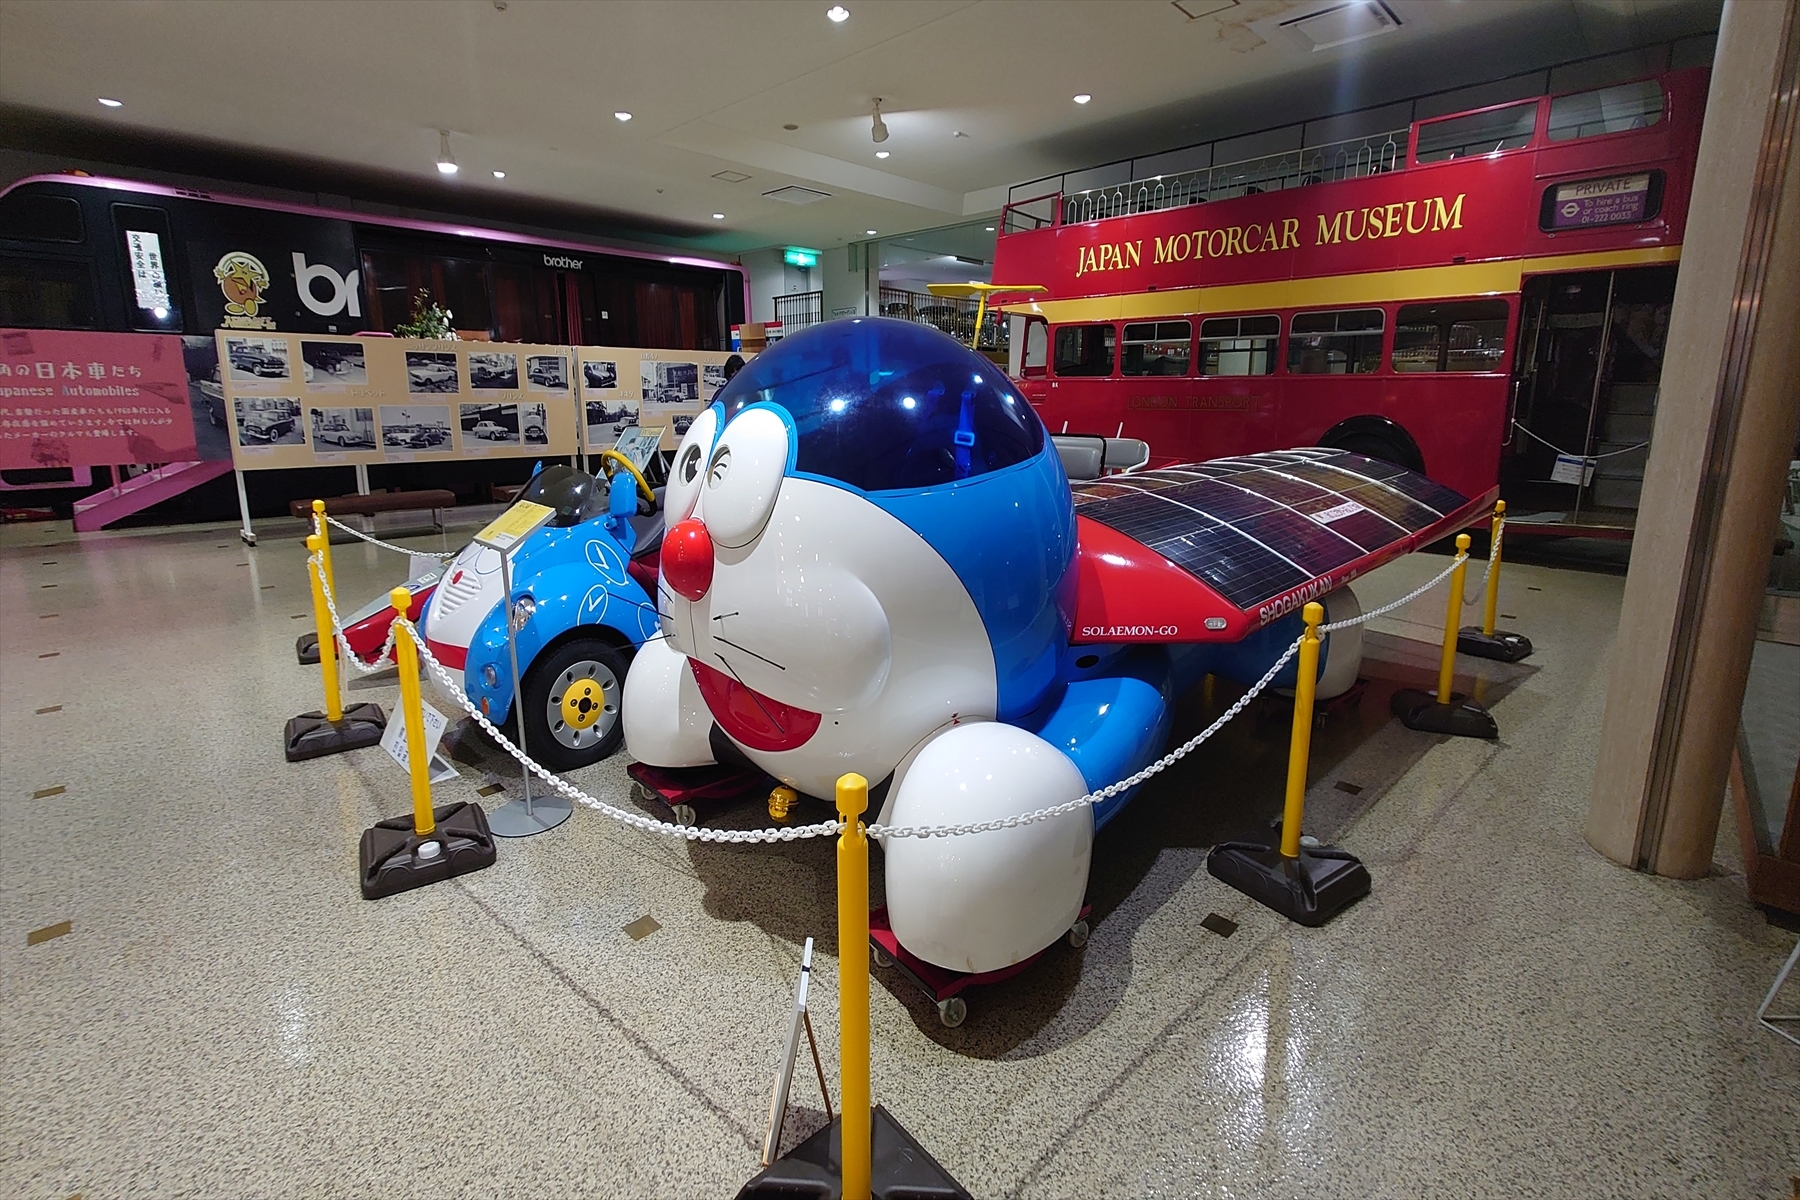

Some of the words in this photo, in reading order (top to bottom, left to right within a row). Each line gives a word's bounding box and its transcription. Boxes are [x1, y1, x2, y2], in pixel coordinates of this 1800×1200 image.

[1575, 178, 1631, 195] PRIVATE
[1584, 199, 1593, 207] To
[1596, 197, 1611, 206] hire
[1623, 195, 1639, 203] bus
[1594, 204, 1619, 213] coach
[1622, 203, 1639, 212] ring
[1581, 214, 1608, 224] 01-222
[1611, 211, 1631, 220] 0033
[1076, 240, 1142, 278] JAPAN
[1153, 218, 1300, 264] MOTORCAR
[1315, 194, 1466, 245] MUSEUM
[543, 254, 583, 270] brother
[62, 385, 140, 397] Automobiles
[1127, 396, 1178, 409] LONDON
[1186, 395, 1262, 410] TRANSPORT
[1259, 575, 1333, 627] SHOGAKUKAN
[1082, 625, 1178, 637] SOLAEMON-GO
